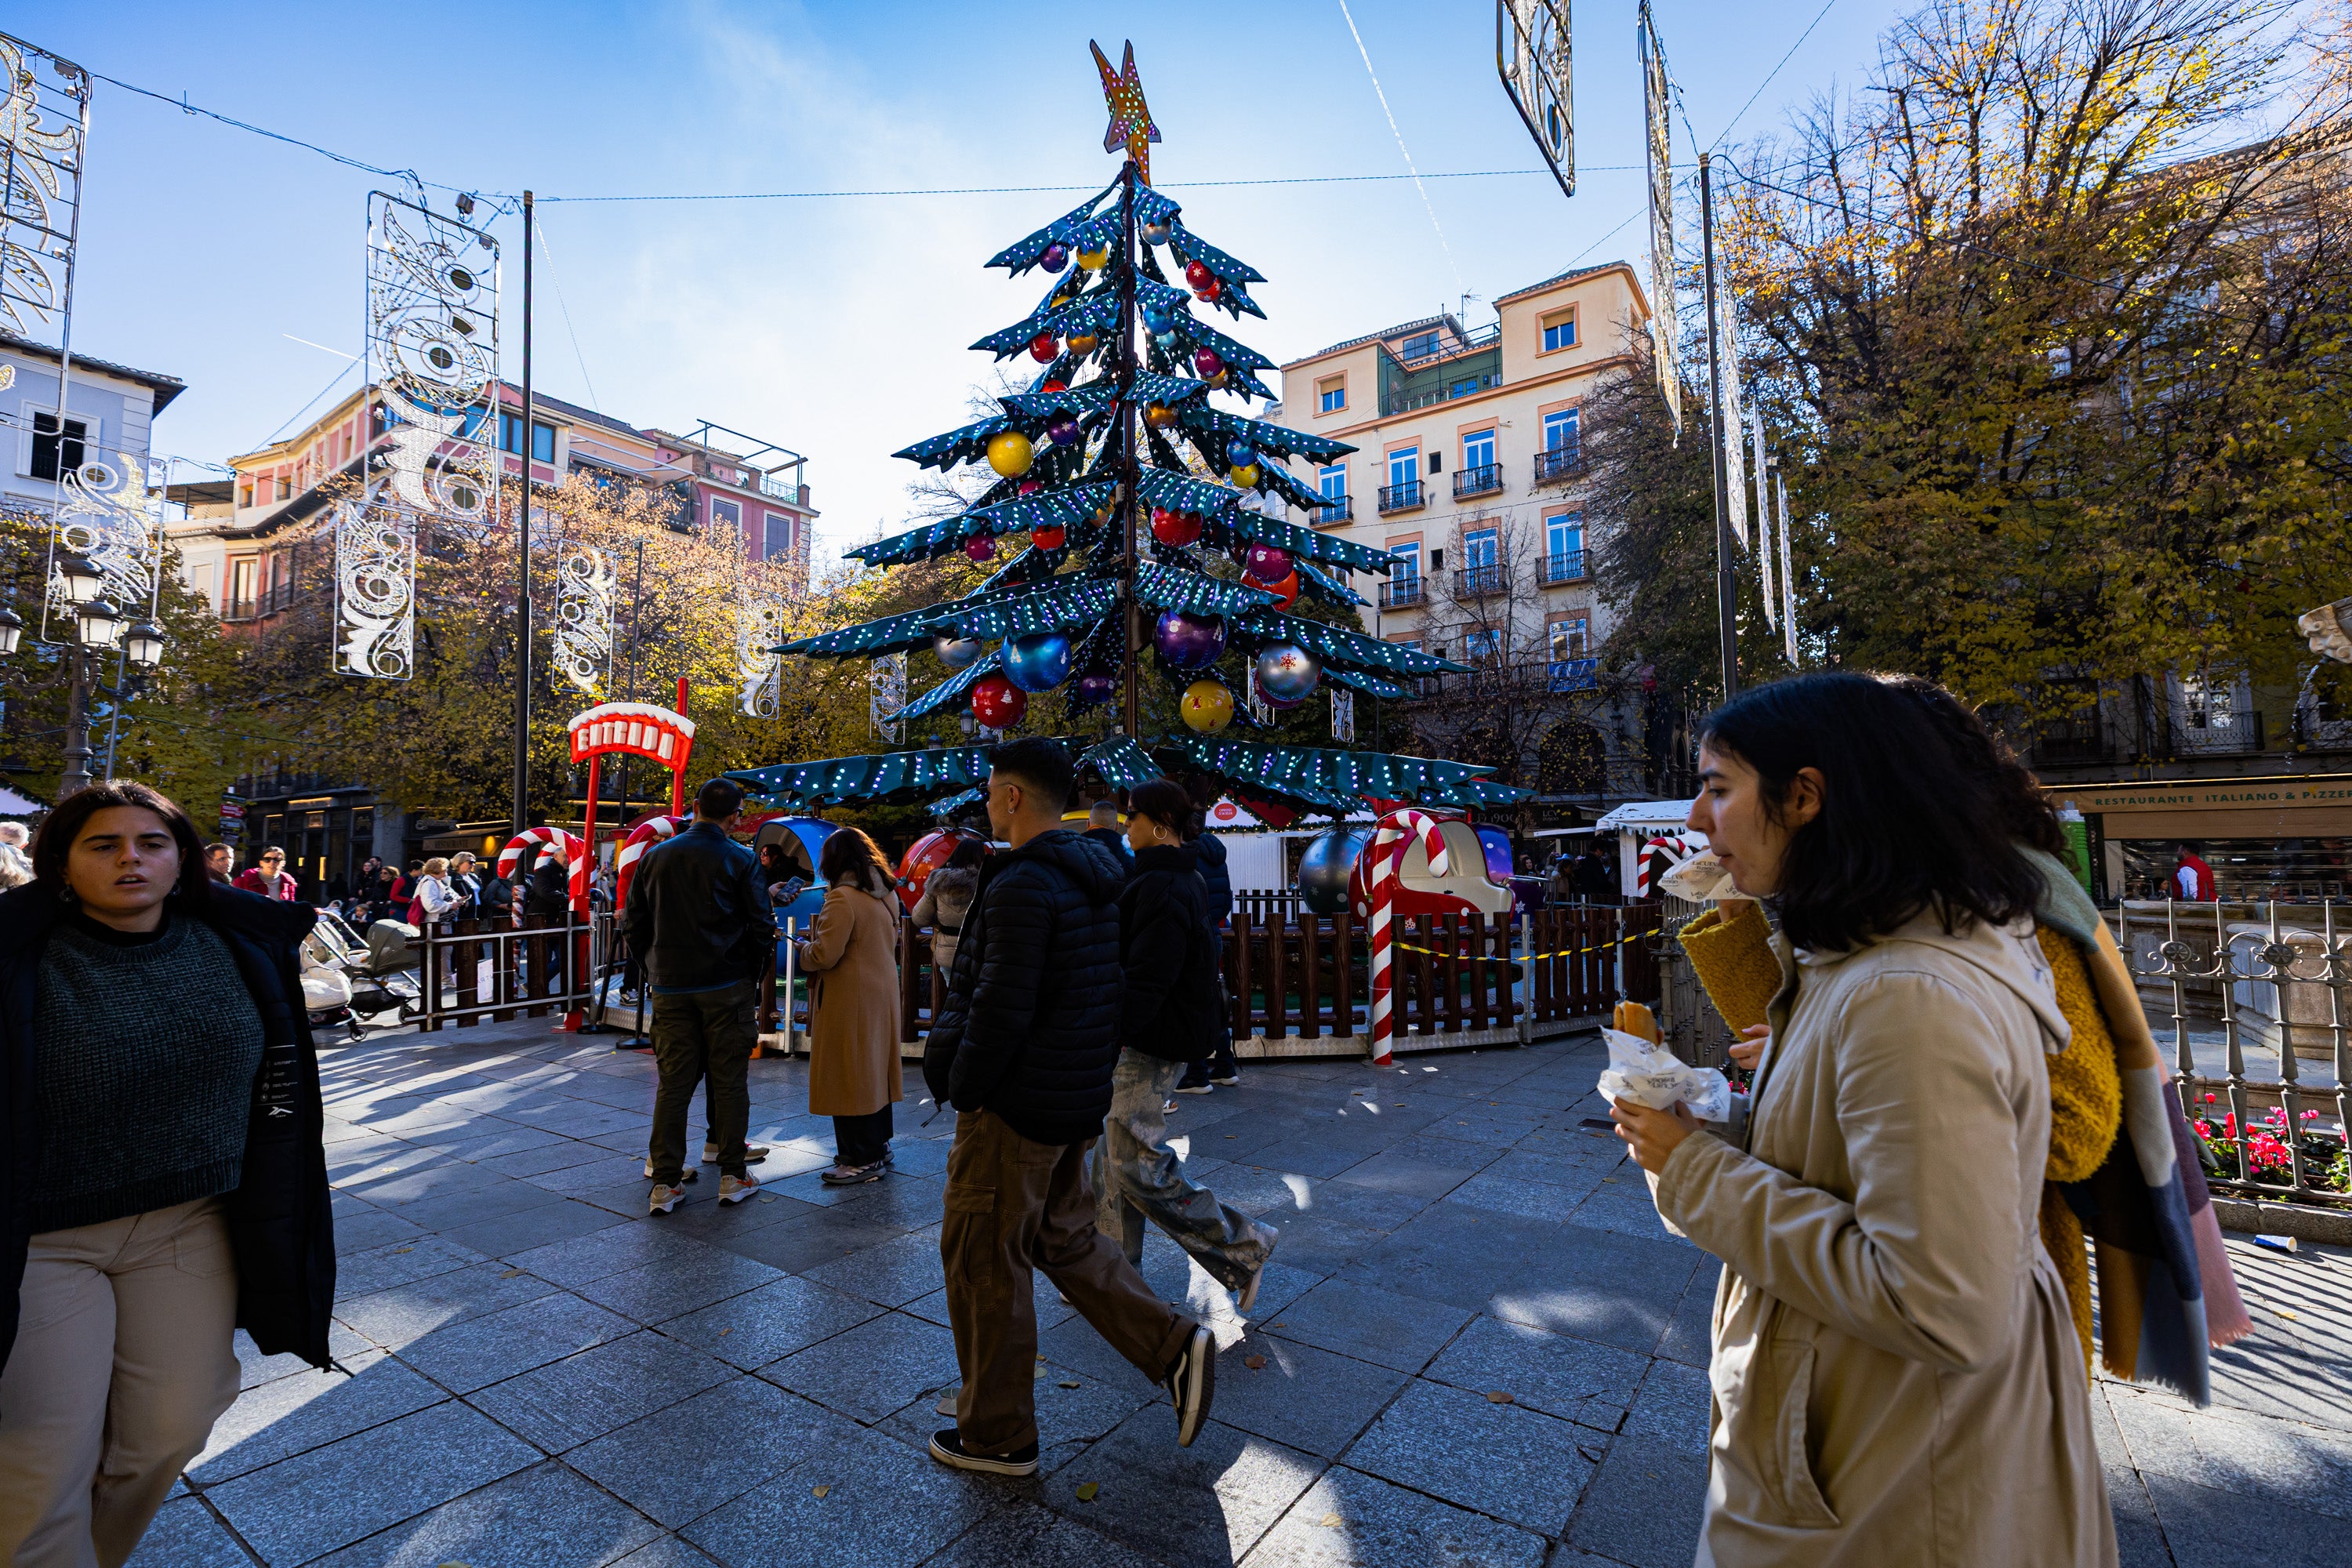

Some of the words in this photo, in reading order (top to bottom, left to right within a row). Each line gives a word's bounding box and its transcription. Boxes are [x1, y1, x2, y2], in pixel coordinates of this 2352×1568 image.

[578, 720, 674, 760] ENTRADA
[2096, 795, 2194, 806] RESTAURANTE
[2205, 793, 2279, 802] ITALIANO
